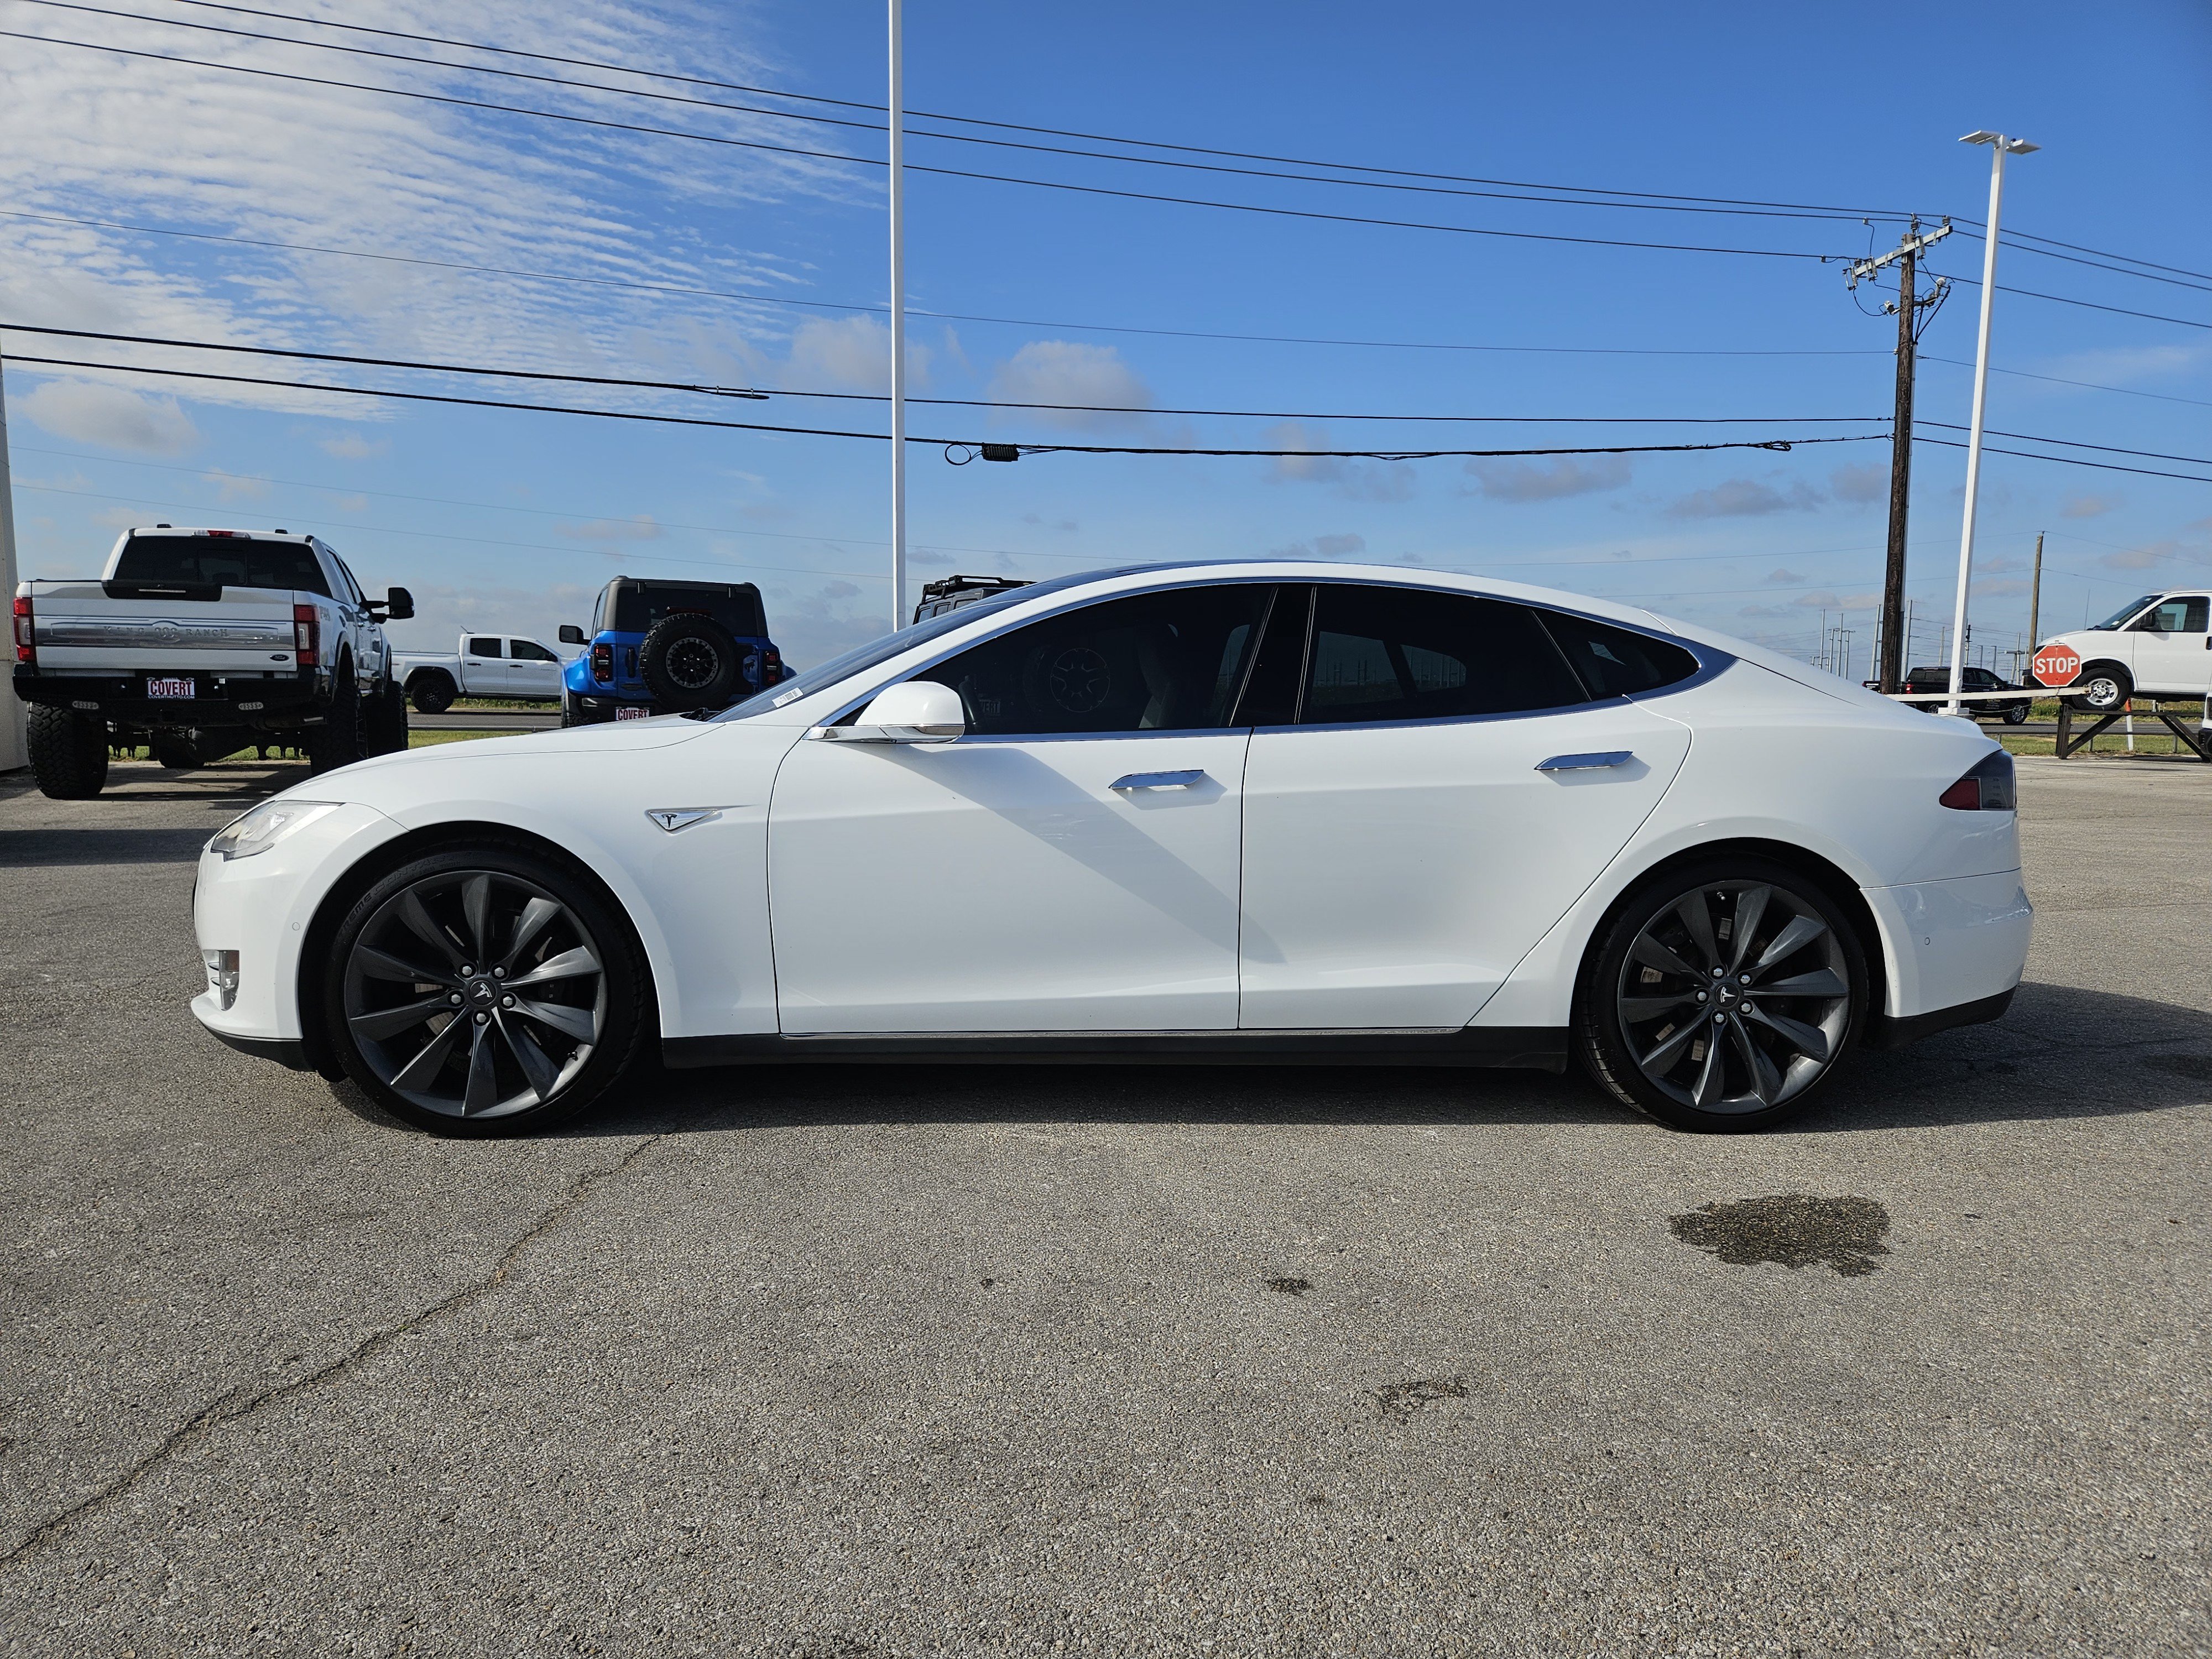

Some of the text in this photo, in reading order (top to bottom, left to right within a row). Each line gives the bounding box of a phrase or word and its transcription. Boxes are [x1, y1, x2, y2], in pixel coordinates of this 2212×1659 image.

[103, 625, 228, 637] KING RANCH
[2036, 657, 2078, 674] STOP
[150, 681, 192, 695] COVERT
[618, 709, 648, 721] COVERT
